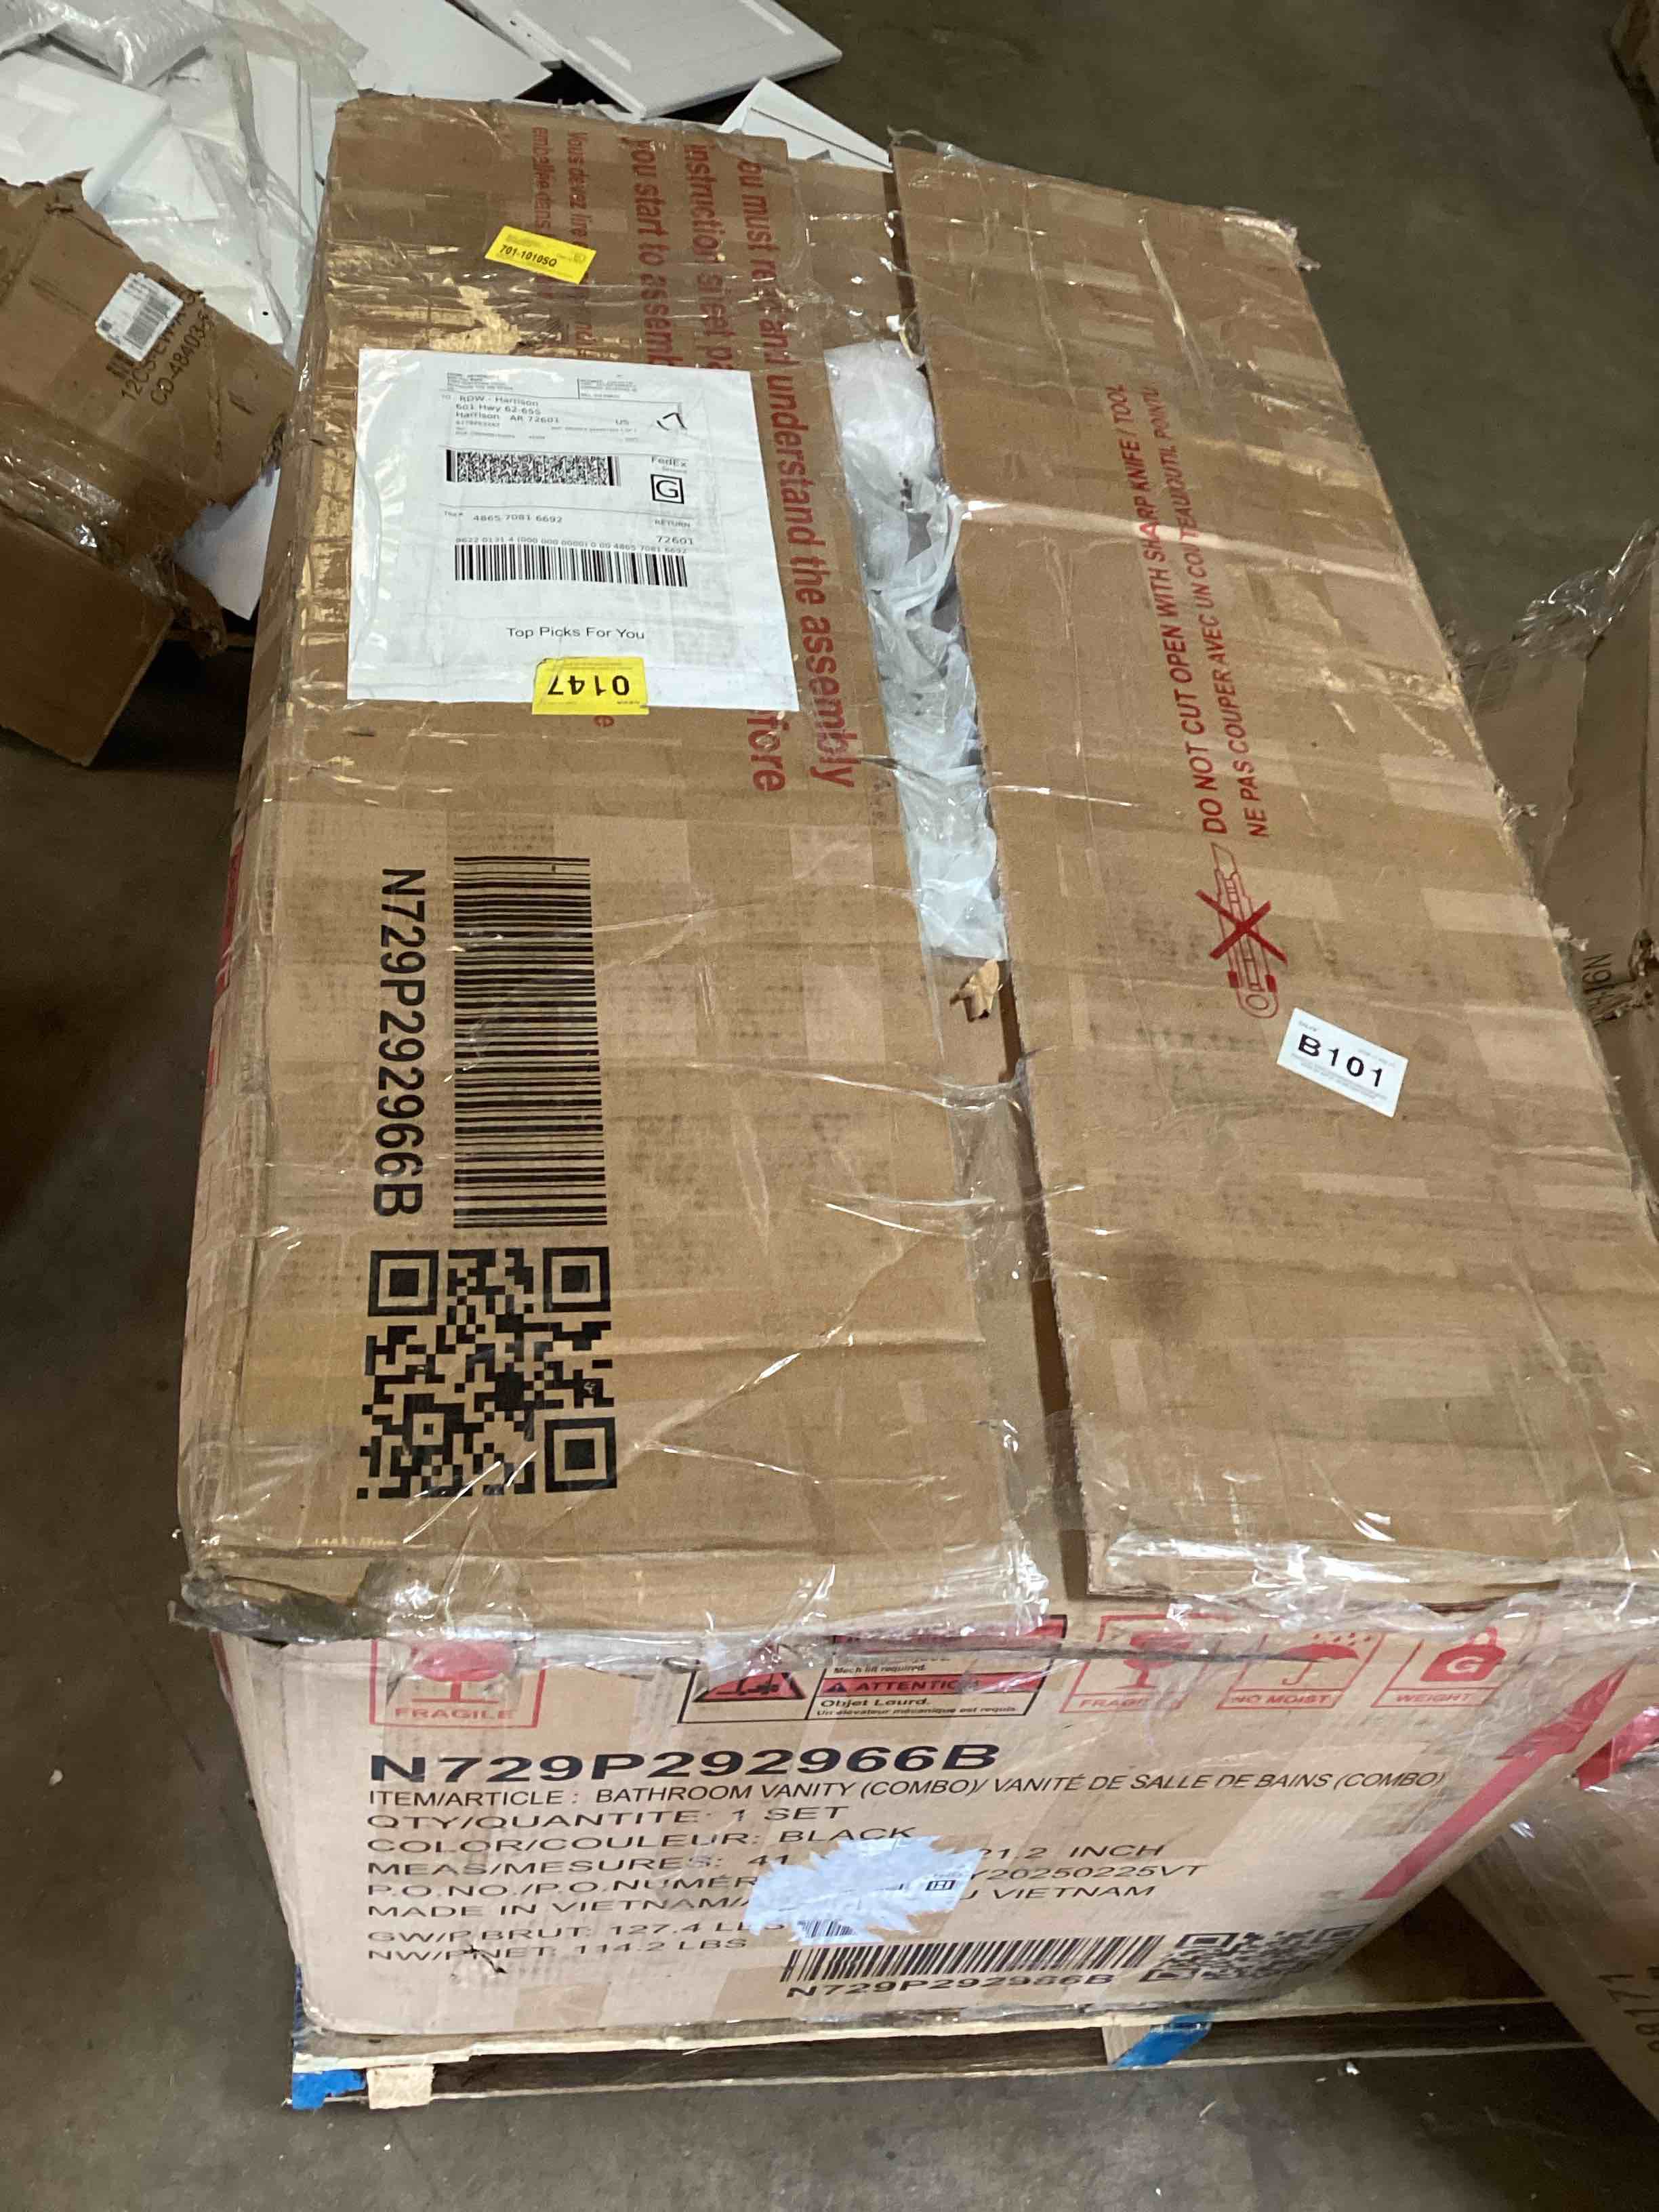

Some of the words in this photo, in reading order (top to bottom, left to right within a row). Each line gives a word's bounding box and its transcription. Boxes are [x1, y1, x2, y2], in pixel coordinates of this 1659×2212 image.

[621, 137, 657, 178] you
[737, 159, 766, 188] ou
[634, 184, 669, 237] start
[683, 143, 726, 264] instruction
[741, 194, 779, 258] must
[638, 243, 669, 266] to
[640, 276, 683, 367] assemb
[759, 319, 802, 367] and
[455, 411, 499, 419] Harrison
[527, 415, 559, 424] 72601
[478, 404, 501, 413] Hwy
[495, 396, 539, 407] Harrison
[1107, 383, 1135, 424] TOOL
[651, 455, 687, 467] FedEx
[766, 374, 827, 546] understand
[1120, 438, 1150, 490] KNIFE
[655, 480, 679, 498] G
[535, 515, 563, 524] 6692
[654, 519, 691, 528] RETURN
[1134, 495, 1166, 562] SHARP
[656, 535, 693, 546] 72601
[790, 556, 831, 605] the
[1148, 567, 1180, 618] WITH
[1191, 581, 1214, 609] UN
[506, 627, 534, 641] Top
[539, 626, 581, 638] Picks
[586, 627, 613, 639] For
[616, 628, 645, 640] You
[1198, 613, 1227, 664] AVEC
[1160, 624, 1193, 684] OPEN
[547, 674, 630, 697] 0147
[801, 615, 862, 788] assembly
[1173, 688, 1204, 735] CUT
[1211, 668, 1248, 754] COUPER
[1186, 741, 1218, 792] NOT
[1232, 759, 1261, 801] PAS
[1198, 798, 1228, 835] DO
[1244, 806, 1269, 838] NE
[373, 868, 426, 1217] N729P292966B
[1298, 1034, 1384, 1088] B101
[1446, 1656, 1485, 1674] G
[394, 1706, 516, 1720] FRAGILE
[821, 1698, 869, 1708] Objet
[1231, 1695, 1258, 1704] NO
[1266, 1694, 1330, 1704] MOIST
[1395, 1693, 1472, 1703] WEIGHT
[371, 1744, 1000, 1784] N729P292966B
[596, 1783, 752, 1804] BATHROOM
[760, 1782, 856, 1801] VANITY
[860, 1778, 985, 1800] (COMBO)/
[989, 1774, 1087, 1793] VANITÉ
[1088, 1775, 1130, 1790] DE
[1130, 1774, 1215, 1790] SALLE
[1216, 1774, 1252, 1789] DE
[1254, 1773, 1334, 1789] BAINS
[1334, 1771, 1448, 1790] (COMBO)
[732, 1809, 745, 1822] 1
[764, 1805, 850, 1821] SET
[367, 1832, 760, 1853] COLOR/COULEUR:
[779, 1826, 917, 1844] BLACK
[368, 1855, 722, 1875] MEAS/MESURES:
[1069, 1844, 1167, 1858] INCH
[368, 1874, 758, 1897] P.O.NO./P.O.NUMÉR
[368, 1905, 484, 1917] MADE
[500, 1904, 537, 1915] IN
[993, 1885, 1158, 1900] VIETNAM
[609, 1923, 700, 1936] 127.4
[575, 1941, 665, 1955] 114.2
[678, 1938, 747, 1950] LBS
[786, 1973, 1115, 1999] N729P292966B
